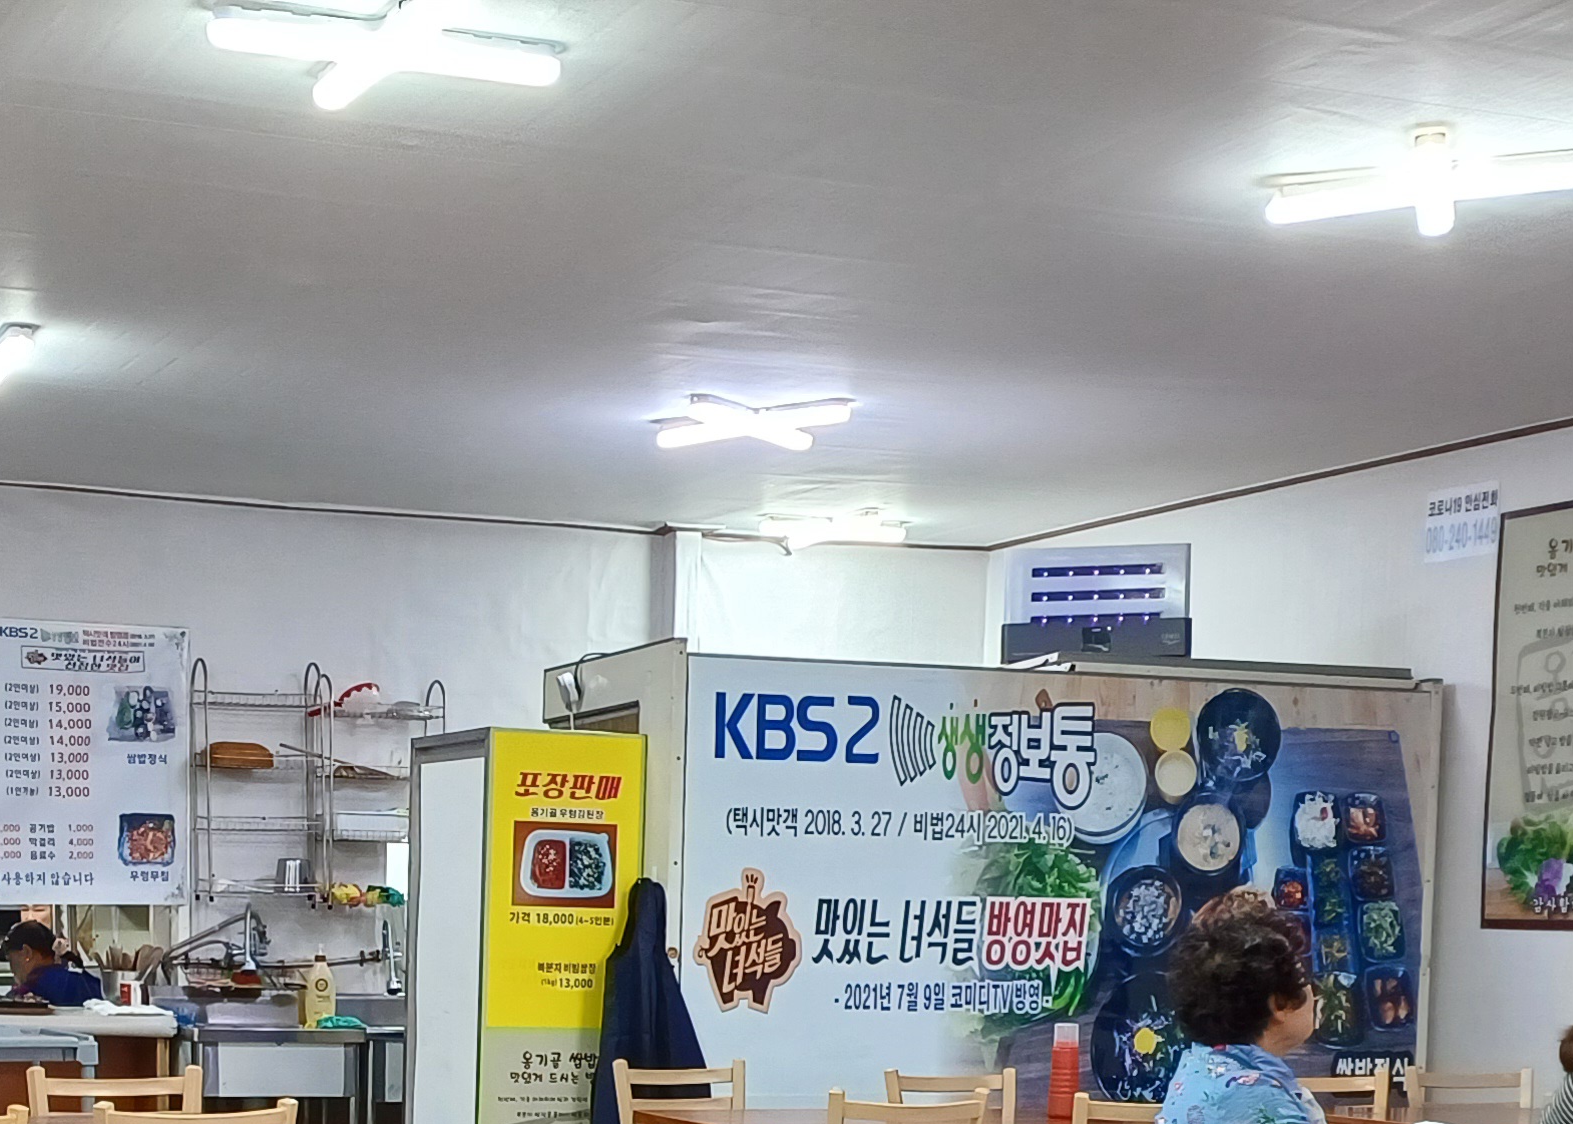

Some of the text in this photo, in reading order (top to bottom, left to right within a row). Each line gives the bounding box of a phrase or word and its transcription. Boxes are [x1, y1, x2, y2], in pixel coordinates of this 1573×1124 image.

[49, 684, 90, 697] 19,000
[48, 701, 91, 714] 15,000
[48, 718, 92, 730] 14,000
[714, 691, 881, 765] KBS2
[49, 735, 91, 747] 14,000
[50, 752, 89, 764] 13,000
[50, 769, 89, 781] 13,000
[48, 786, 90, 798] 13,000
[514, 771, 622, 801] 포장판매
[725, 806, 799, 837] (택시맛객
[804, 811, 846, 837] 2018.
[851, 812, 866, 837] 3.
[870, 812, 893, 837] 27
[913, 811, 983, 845] 비법24시
[987, 814, 1028, 840] 2021.
[1031, 815, 1047, 841] 4.
[1051, 815, 1074, 845] 16)
[509, 911, 531, 924] 가격
[536, 912, 574, 926] 18,000
[707, 902, 767, 957] 맛있는
[811, 897, 1089, 971] 맛있는 녀석들 방영맛집
[722, 933, 784, 993] 녀석들
[558, 978, 594, 990] 13,000
[843, 981, 1041, 1012] 2021년 7월 9일 코미디TV 방영
